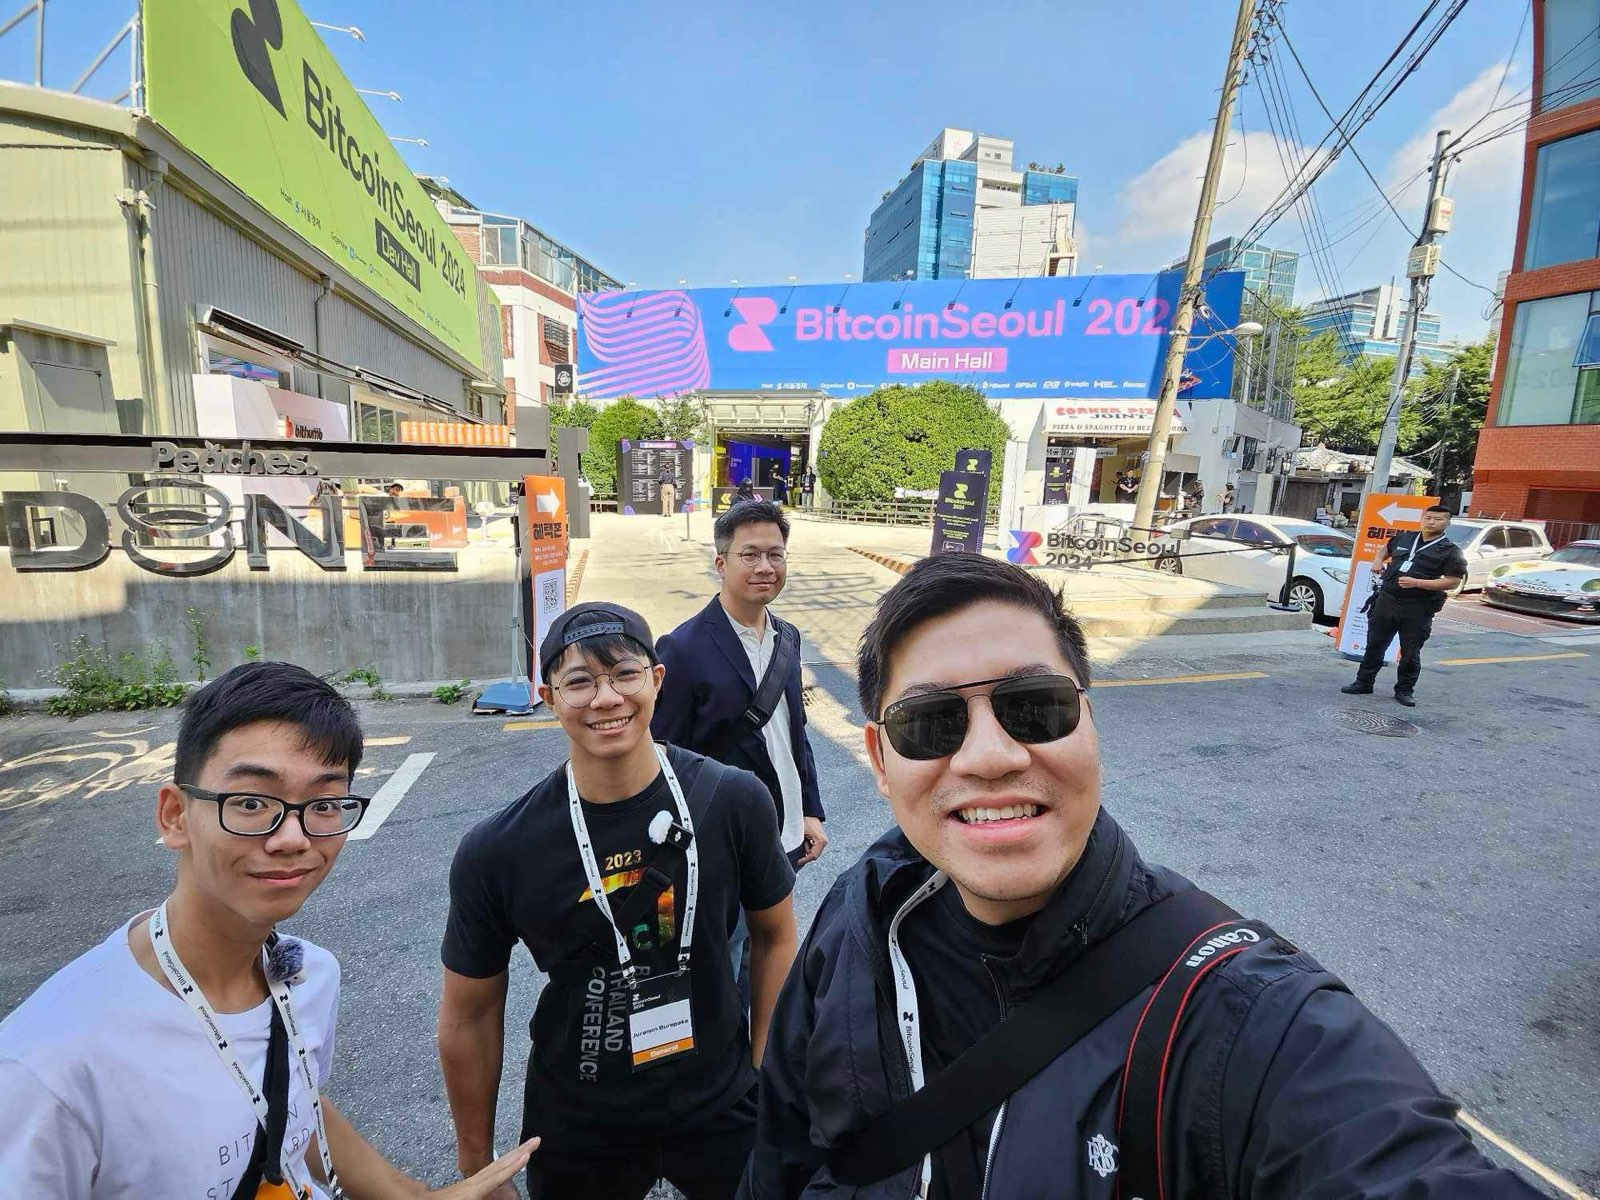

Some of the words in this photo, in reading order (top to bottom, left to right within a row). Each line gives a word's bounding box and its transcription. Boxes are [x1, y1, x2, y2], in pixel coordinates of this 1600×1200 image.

[303, 58, 436, 269] BitcoinSeoul
[441, 242, 466, 301] 2024
[382, 230, 400, 268] Dev
[401, 251, 417, 285] Hall
[796, 298, 1063, 341] BitcoinSeoul
[1085, 298, 1178, 336] 202
[901, 351, 949, 369] Main
[955, 351, 993, 369] Hall
[295, 424, 323, 440] bithumb
[150, 439, 319, 475] Peaches.
[1046, 552, 1093, 570] 2024
[1047, 533, 1181, 555] BitcoinSeoul
[1185, 928, 1260, 968] Canon
[163, 950, 187, 986] BitcoinSeoul
[198, 1005, 222, 1041] BitcoinSeoul
[905, 1025, 917, 1075] BitcoinSeoul
